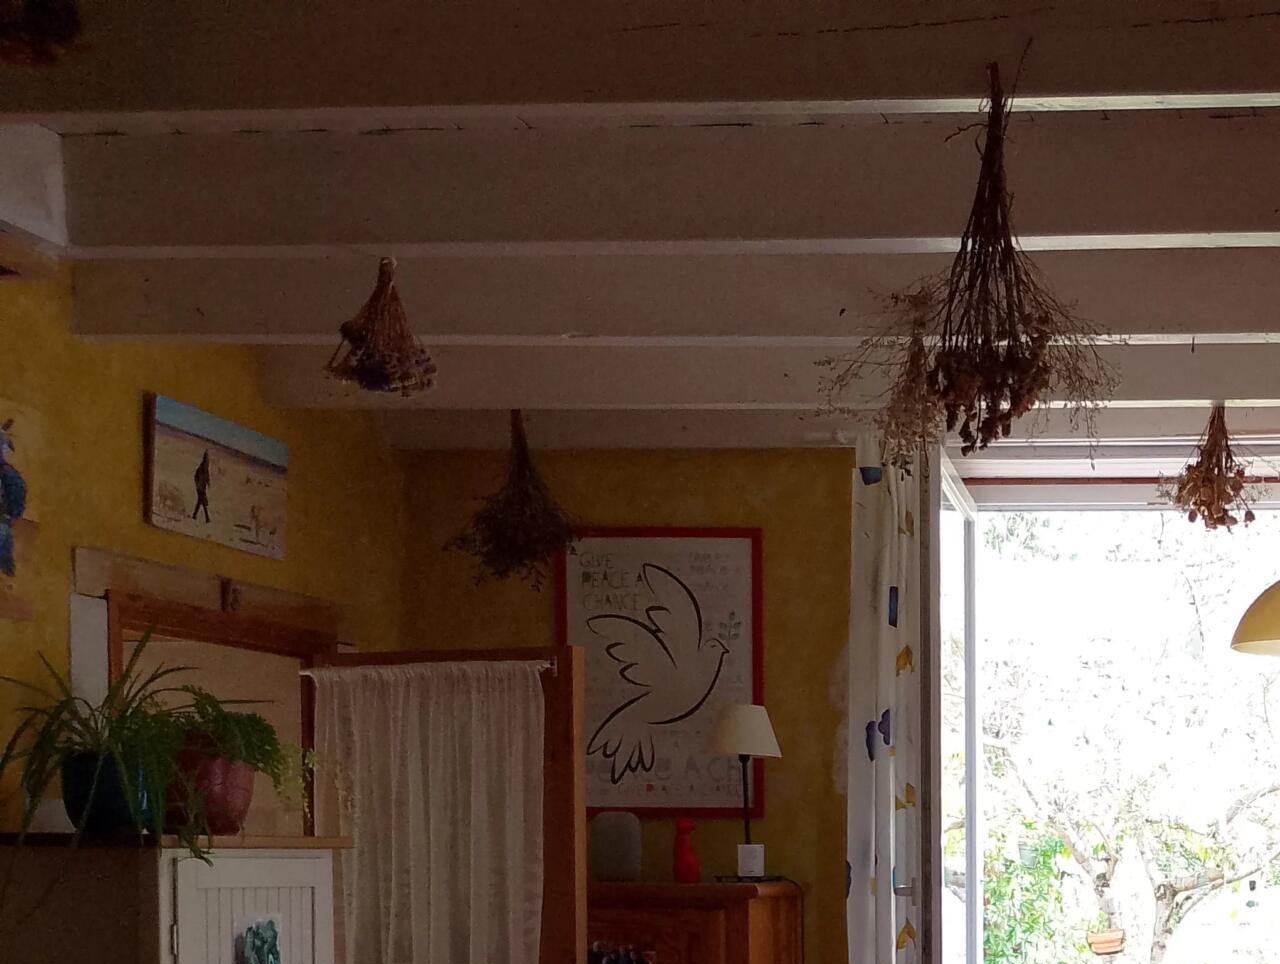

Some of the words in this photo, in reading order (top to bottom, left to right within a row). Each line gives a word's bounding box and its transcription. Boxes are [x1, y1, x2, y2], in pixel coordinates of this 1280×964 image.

[579, 552, 614, 569] GIVE
[582, 570, 631, 590] PEACE
[635, 571, 646, 588] A
[582, 592, 644, 612] CHANCE
